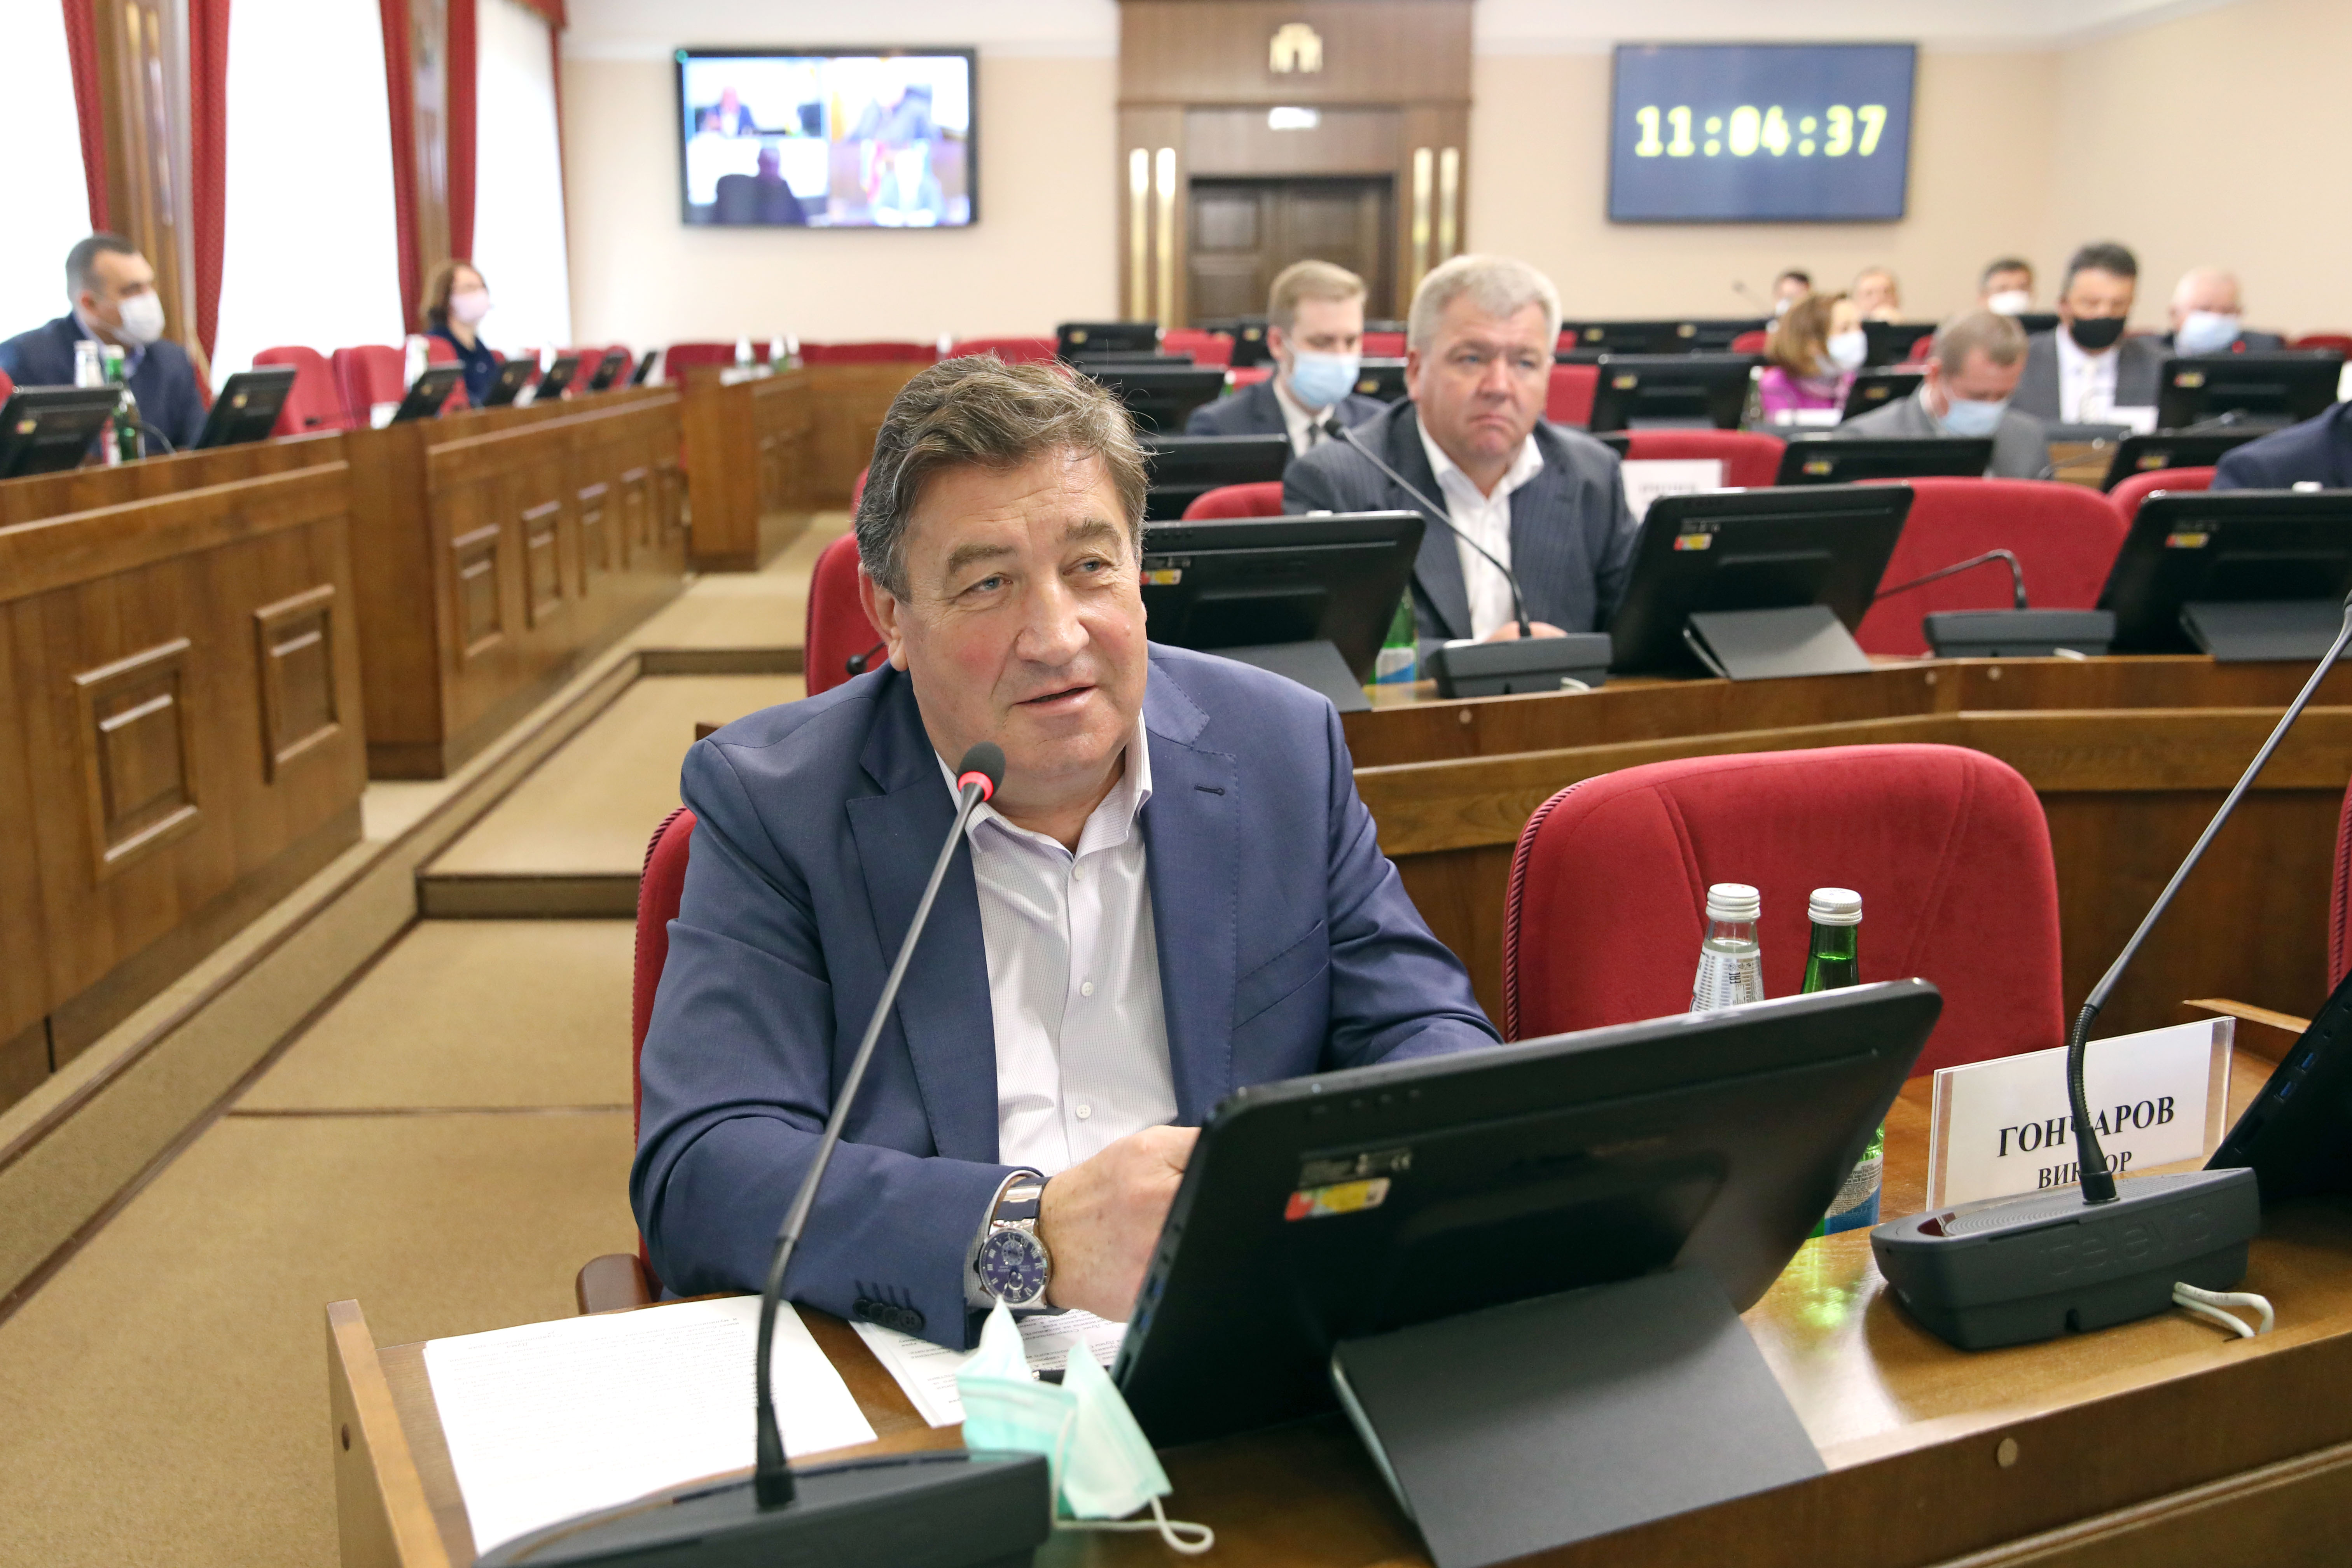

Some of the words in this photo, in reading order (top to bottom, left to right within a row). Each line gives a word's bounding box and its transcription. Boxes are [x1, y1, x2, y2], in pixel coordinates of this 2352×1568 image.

[1635, 105, 1887, 157] 11:04:37
[1729, 972, 1741, 984] EAC
[2038, 1151, 2132, 1189] ВИКОР
